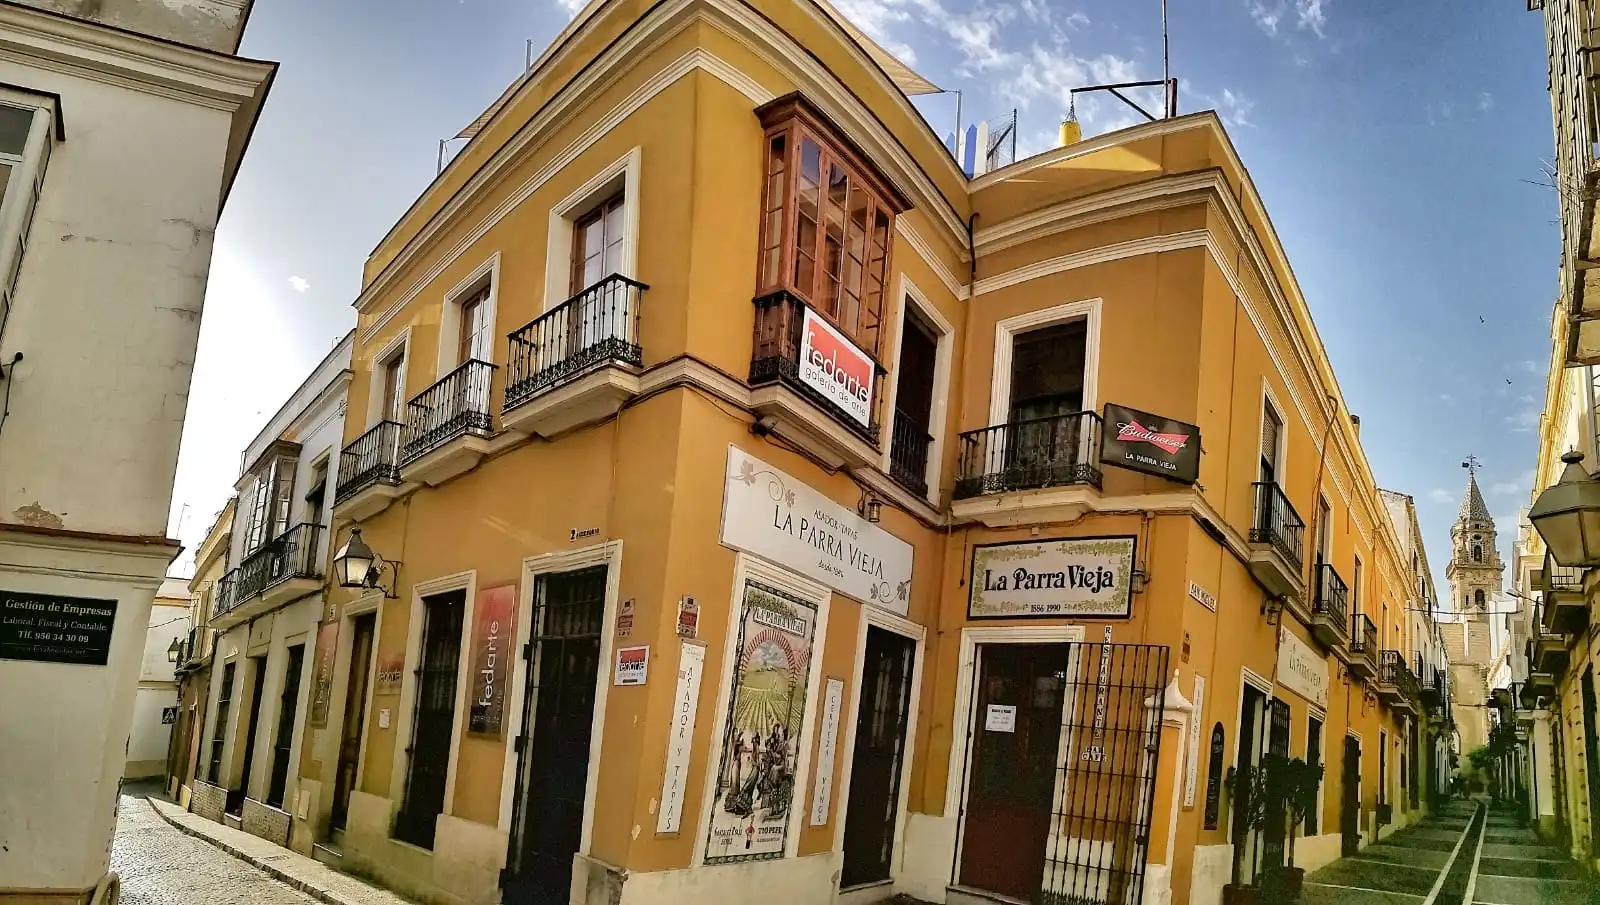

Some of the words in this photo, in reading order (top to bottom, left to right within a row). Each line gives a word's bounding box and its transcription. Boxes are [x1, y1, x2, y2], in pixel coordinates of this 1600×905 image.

[806, 331, 869, 403] fedarte
[838, 387, 849, 404] de
[852, 401, 866, 417] arte
[1116, 422, 1187, 448] Budweiser
[1125, 451, 1134, 460] LA
[1137, 455, 1158, 466] PARRA
[1159, 460, 1177, 471] VIEJA
[774, 504, 793, 535] LA
[799, 517, 842, 561] PARRA
[848, 542, 883, 580] VIEJA
[984, 569, 1008, 591] La
[1012, 567, 1066, 591] Parra
[1067, 565, 1114, 593] Vieja
[5, 598, 45, 612] Gestión
[47, 601, 60, 612] de
[62, 603, 113, 616] Empresas
[1046, 603, 1061, 613] 1990
[38, 619, 62, 629] Fiscal
[52, 633, 63, 641] 34
[66, 634, 77, 642] 30
[78, 635, 89, 643] 09
[478, 620, 499, 706] fedarte
[679, 666, 693, 739] ASADOR
[666, 765, 680, 830] TAPAS
